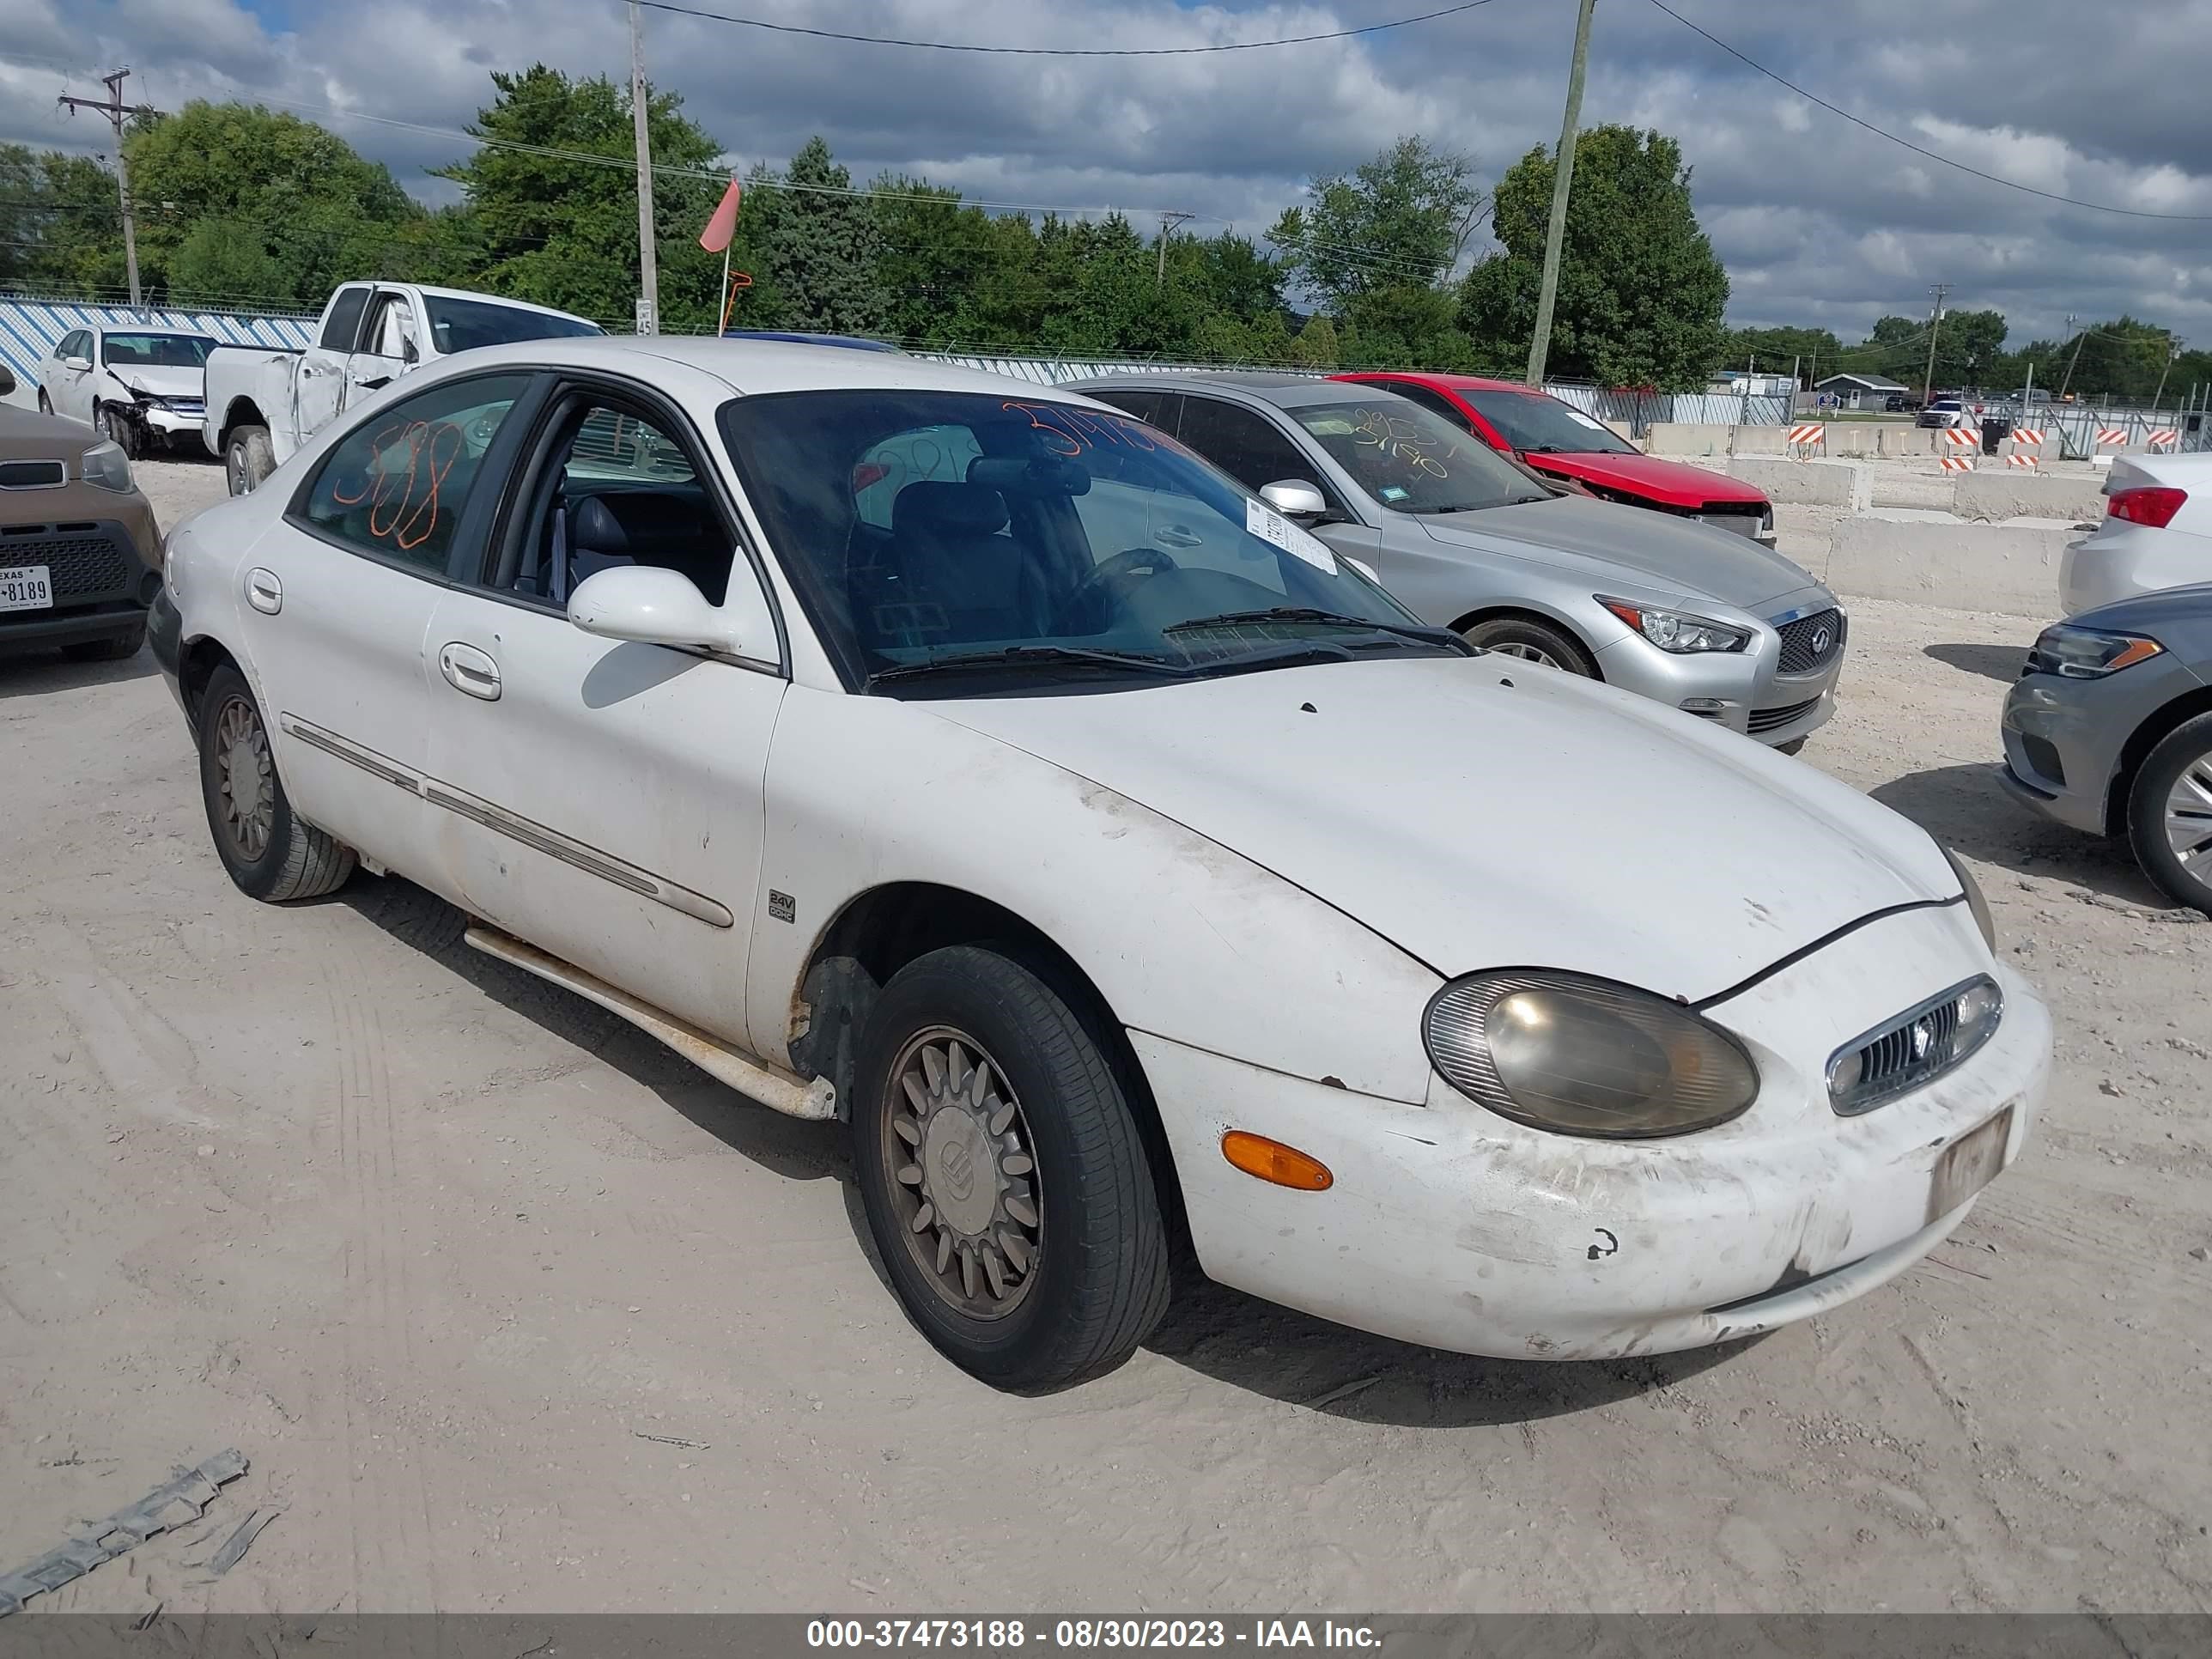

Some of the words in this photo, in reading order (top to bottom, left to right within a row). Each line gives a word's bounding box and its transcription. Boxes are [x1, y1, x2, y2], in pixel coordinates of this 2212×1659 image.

[639, 321, 651, 335] 45
[0, 571, 23, 580] EXAS
[770, 893, 793, 908] 24V
